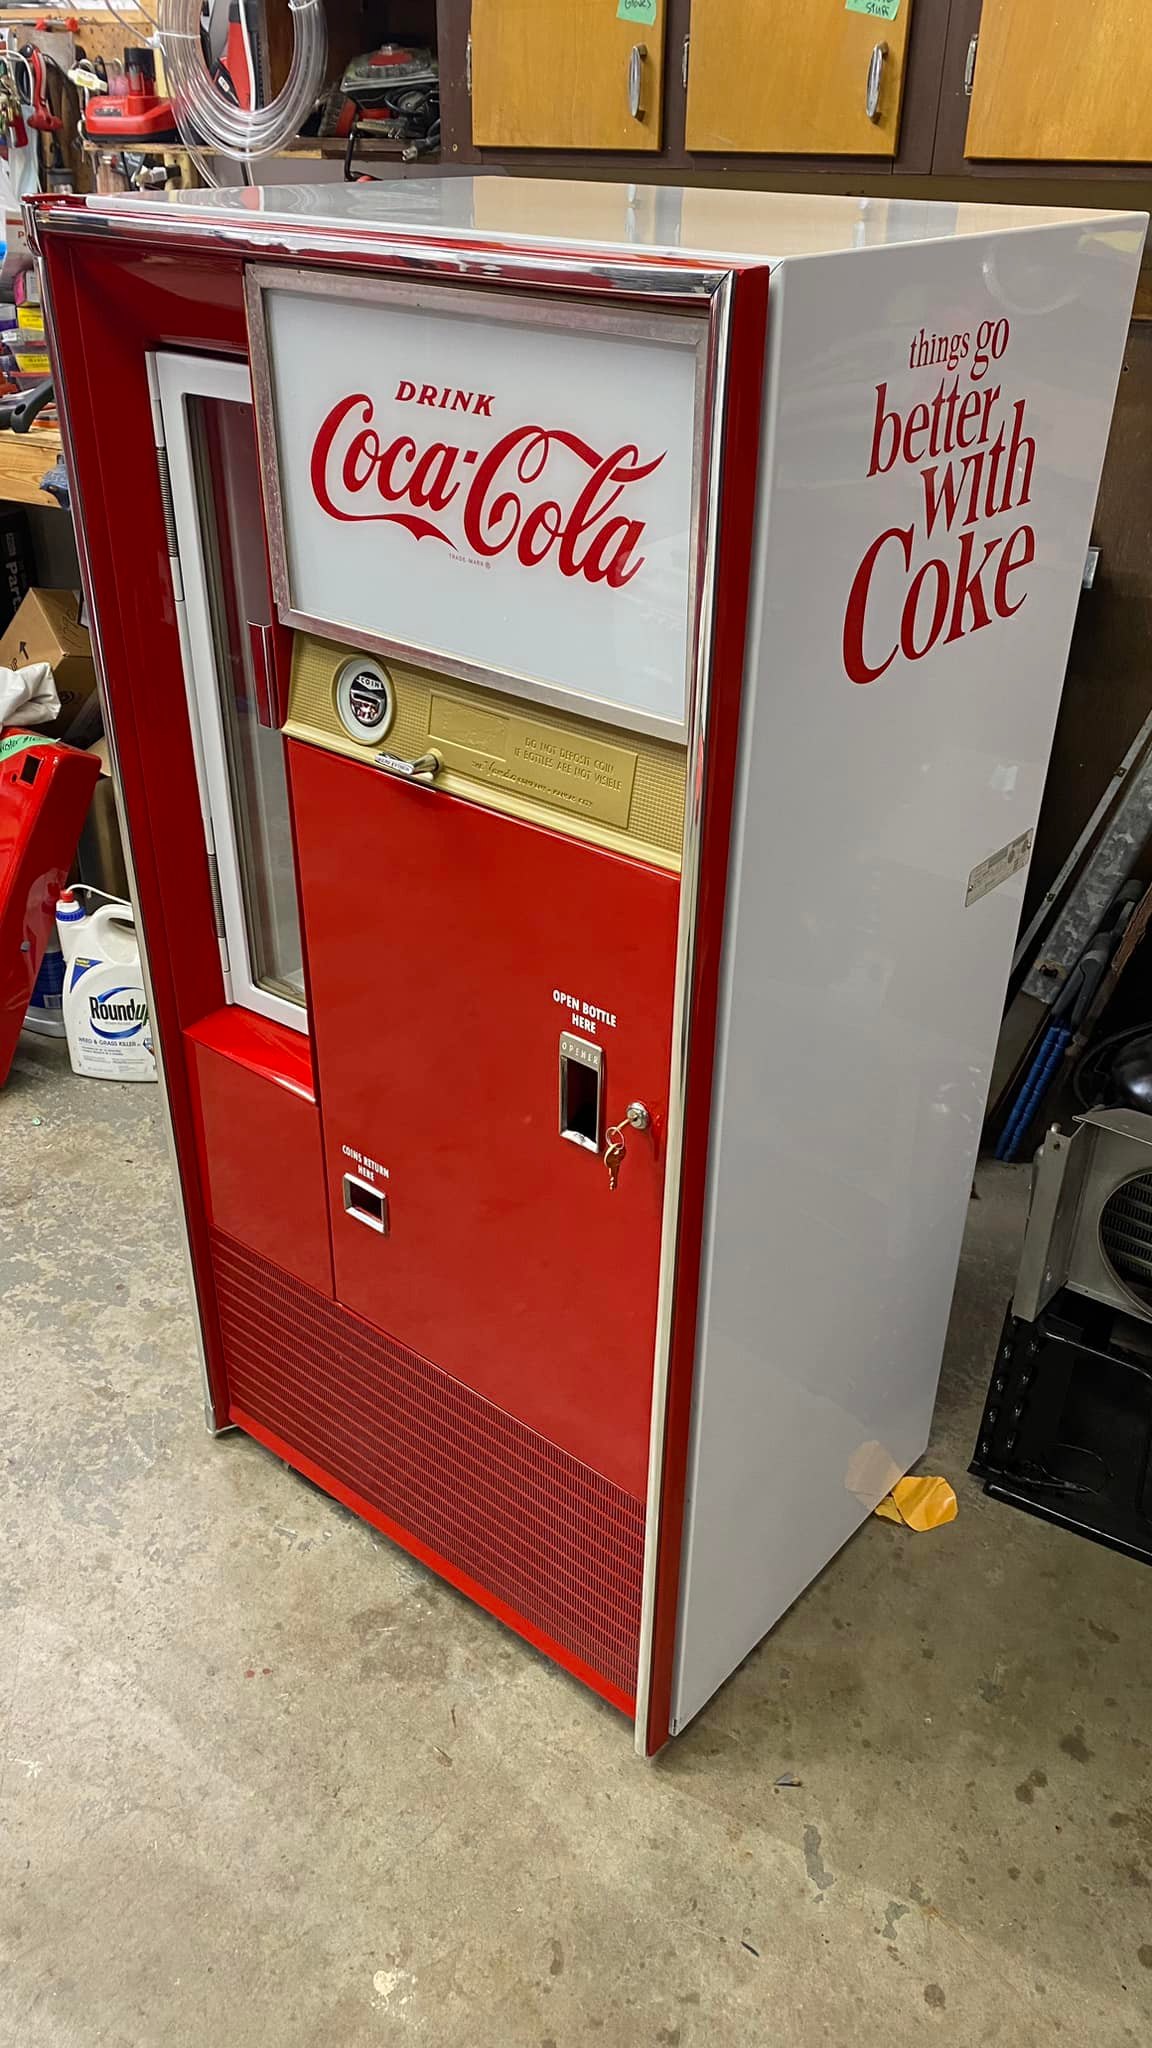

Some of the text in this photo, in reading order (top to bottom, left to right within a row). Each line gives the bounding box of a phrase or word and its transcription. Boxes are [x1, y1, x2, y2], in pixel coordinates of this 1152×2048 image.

[908, 318, 1010, 381] things go
[395, 380, 496, 417] DRINK
[866, 374, 1001, 478] better
[920, 399, 1036, 540] with
[310, 393, 668, 588] Coca-Cola
[842, 523, 1035, 685] Coke
[361, 677, 380, 689] COIN
[523, 751, 553, 768] BOTTLES
[556, 760, 572, 774] ARE
[574, 767, 592, 781] NOT
[594, 772, 623, 793] VISIBLE
[525, 736, 614, 774] DO NOT DEPOSIT COIN
[553, 989, 617, 1028] OPEN BOTTLE
[571, 1012, 597, 1034] HERE
[561, 1041, 599, 1065] OPENER
[342, 1144, 390, 1179] COINS RETURN
[357, 1164, 375, 1182] HERE
